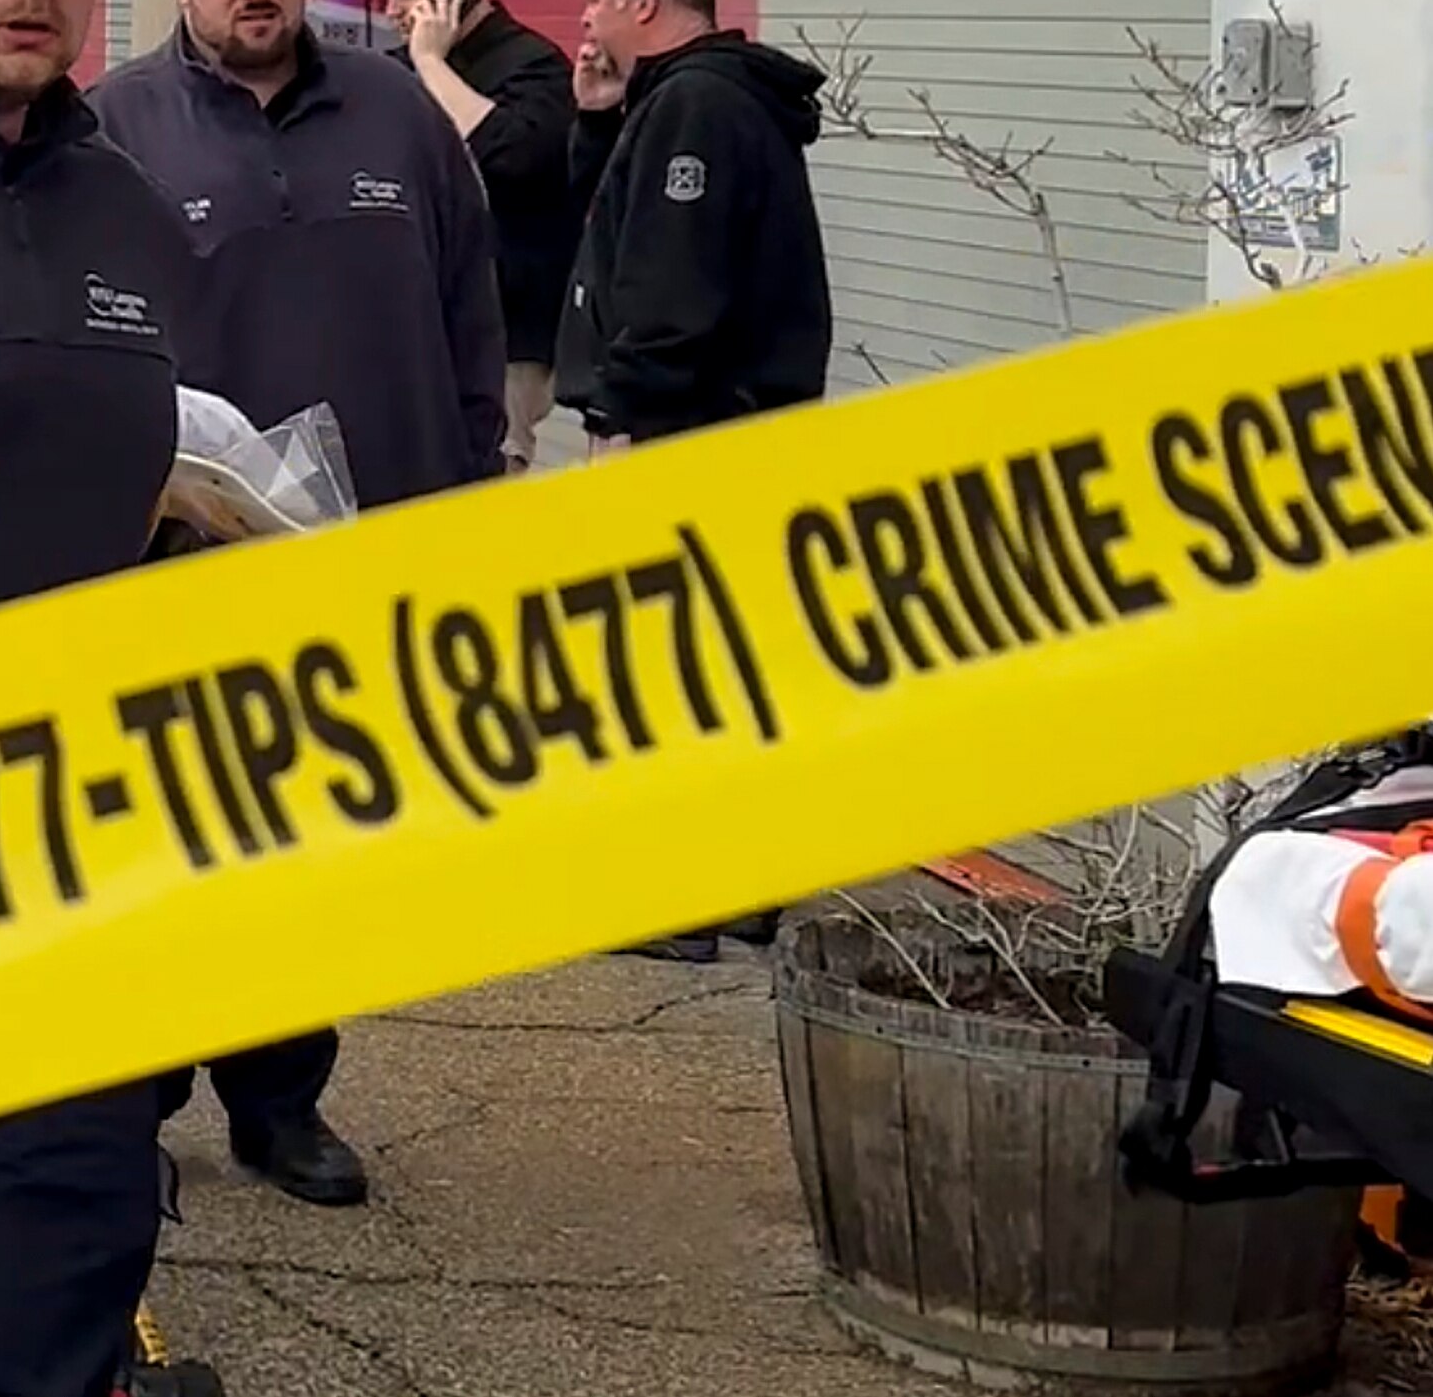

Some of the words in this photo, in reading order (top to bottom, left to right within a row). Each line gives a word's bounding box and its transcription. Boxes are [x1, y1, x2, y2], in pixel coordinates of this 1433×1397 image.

[393, 523, 780, 820] (8477)
[784, 434, 1171, 690] CRIME
[1149, 346, 1433, 589] SCEN
